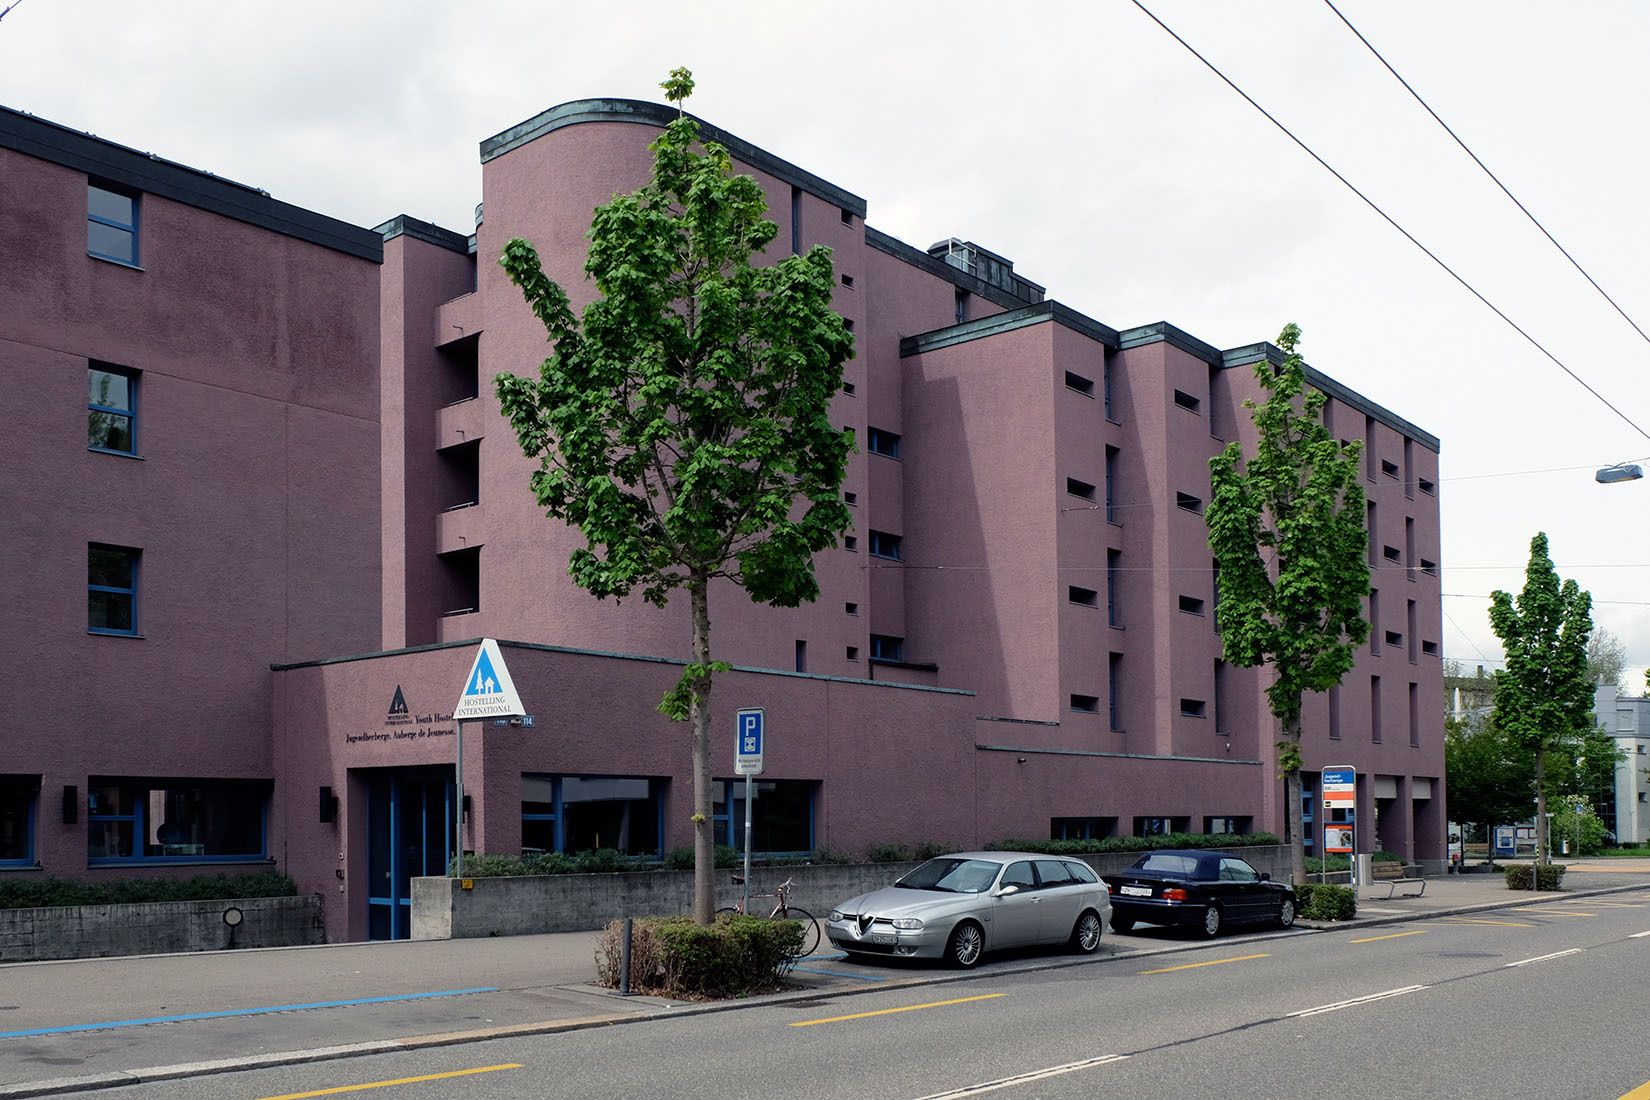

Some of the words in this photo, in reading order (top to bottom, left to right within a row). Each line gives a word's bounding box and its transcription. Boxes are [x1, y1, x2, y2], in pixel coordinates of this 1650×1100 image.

[464, 696, 505, 706] HOSTELLING
[458, 705, 511, 716] INTERNATIONAL
[415, 714, 432, 725] Youth
[746, 717, 756, 736] P
[393, 730, 416, 740] Auberge
[418, 728, 425, 737] de
